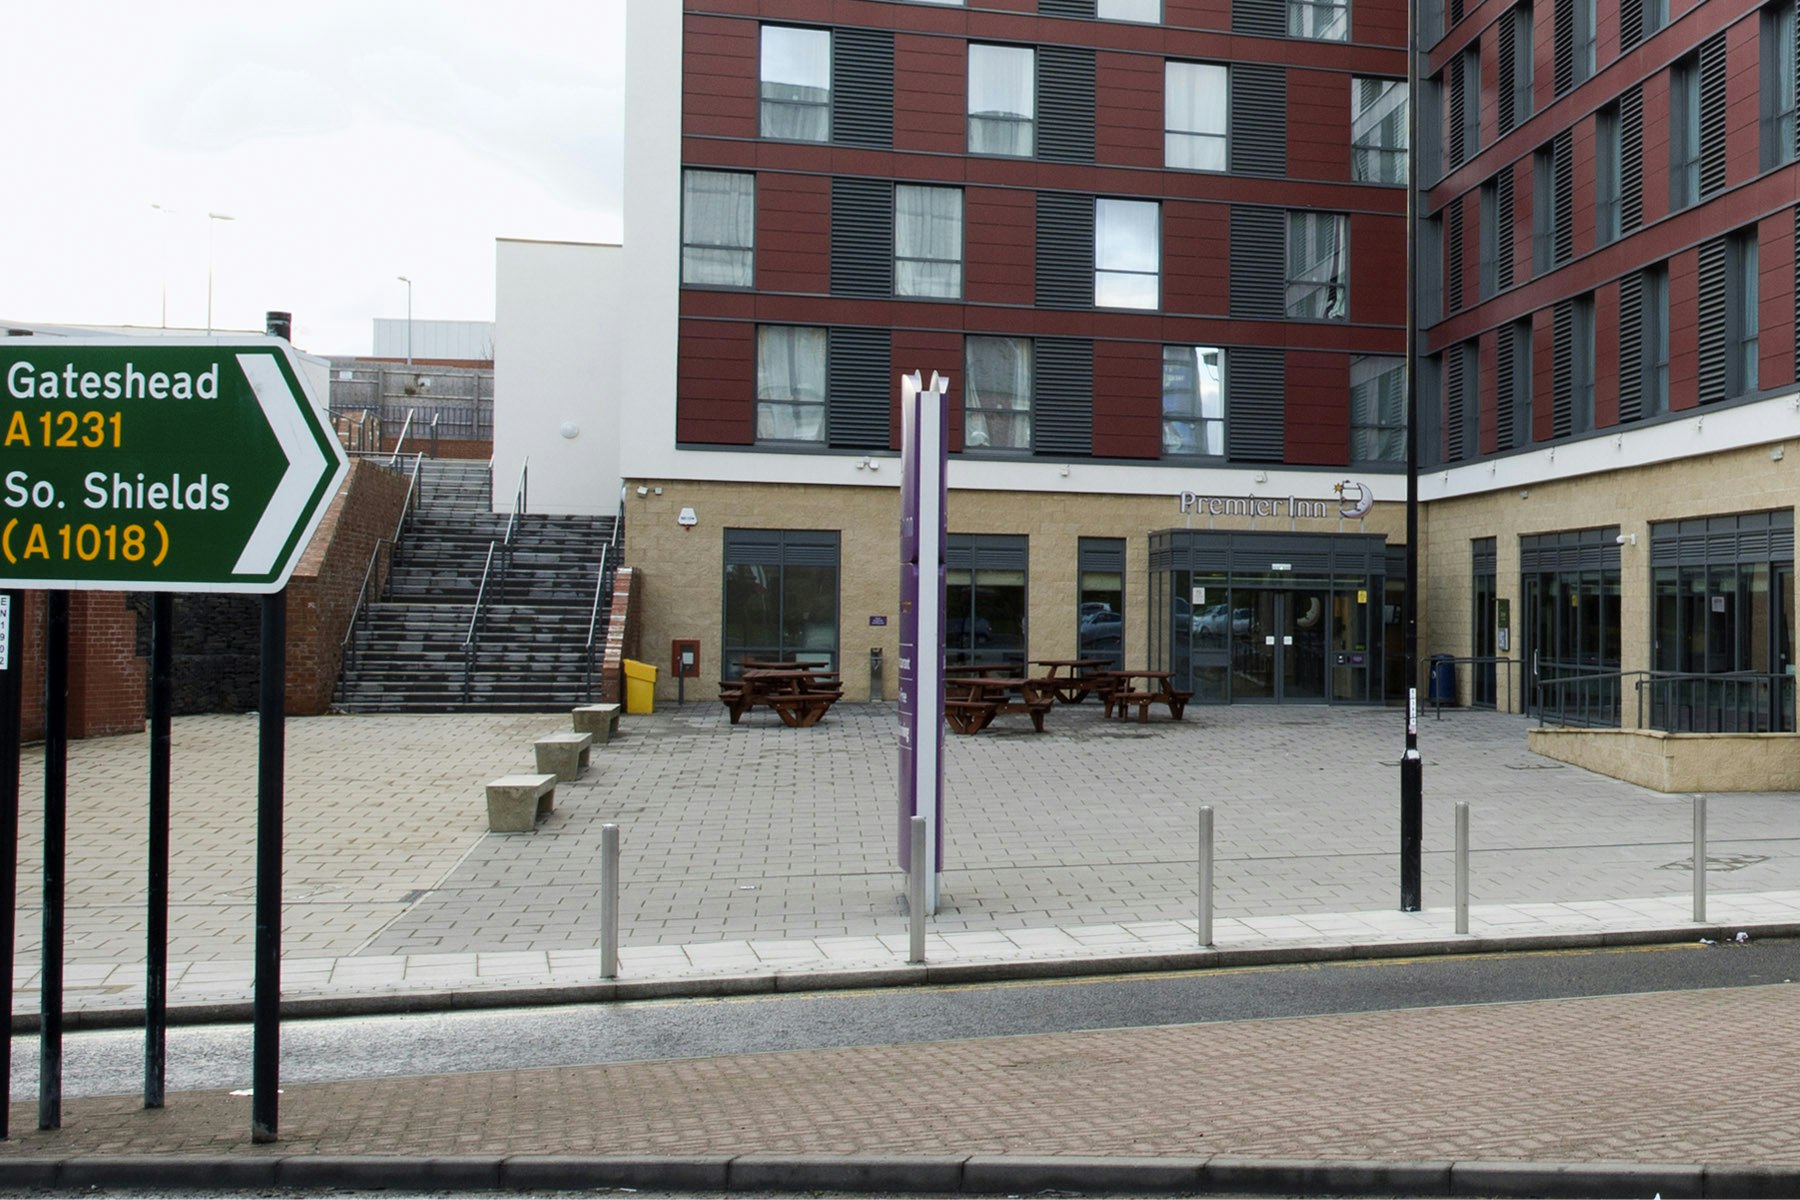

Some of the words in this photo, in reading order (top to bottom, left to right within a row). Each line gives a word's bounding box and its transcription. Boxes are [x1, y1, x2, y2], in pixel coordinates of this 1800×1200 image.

[6, 360, 219, 400] Gateshead
[4, 410, 122, 448] A1231
[4, 470, 66, 509] So.
[83, 471, 231, 511] Shields
[1179, 490, 1283, 517] Premier
[1288, 494, 1328, 518] Inn
[2, 517, 170, 567] (A1018)
